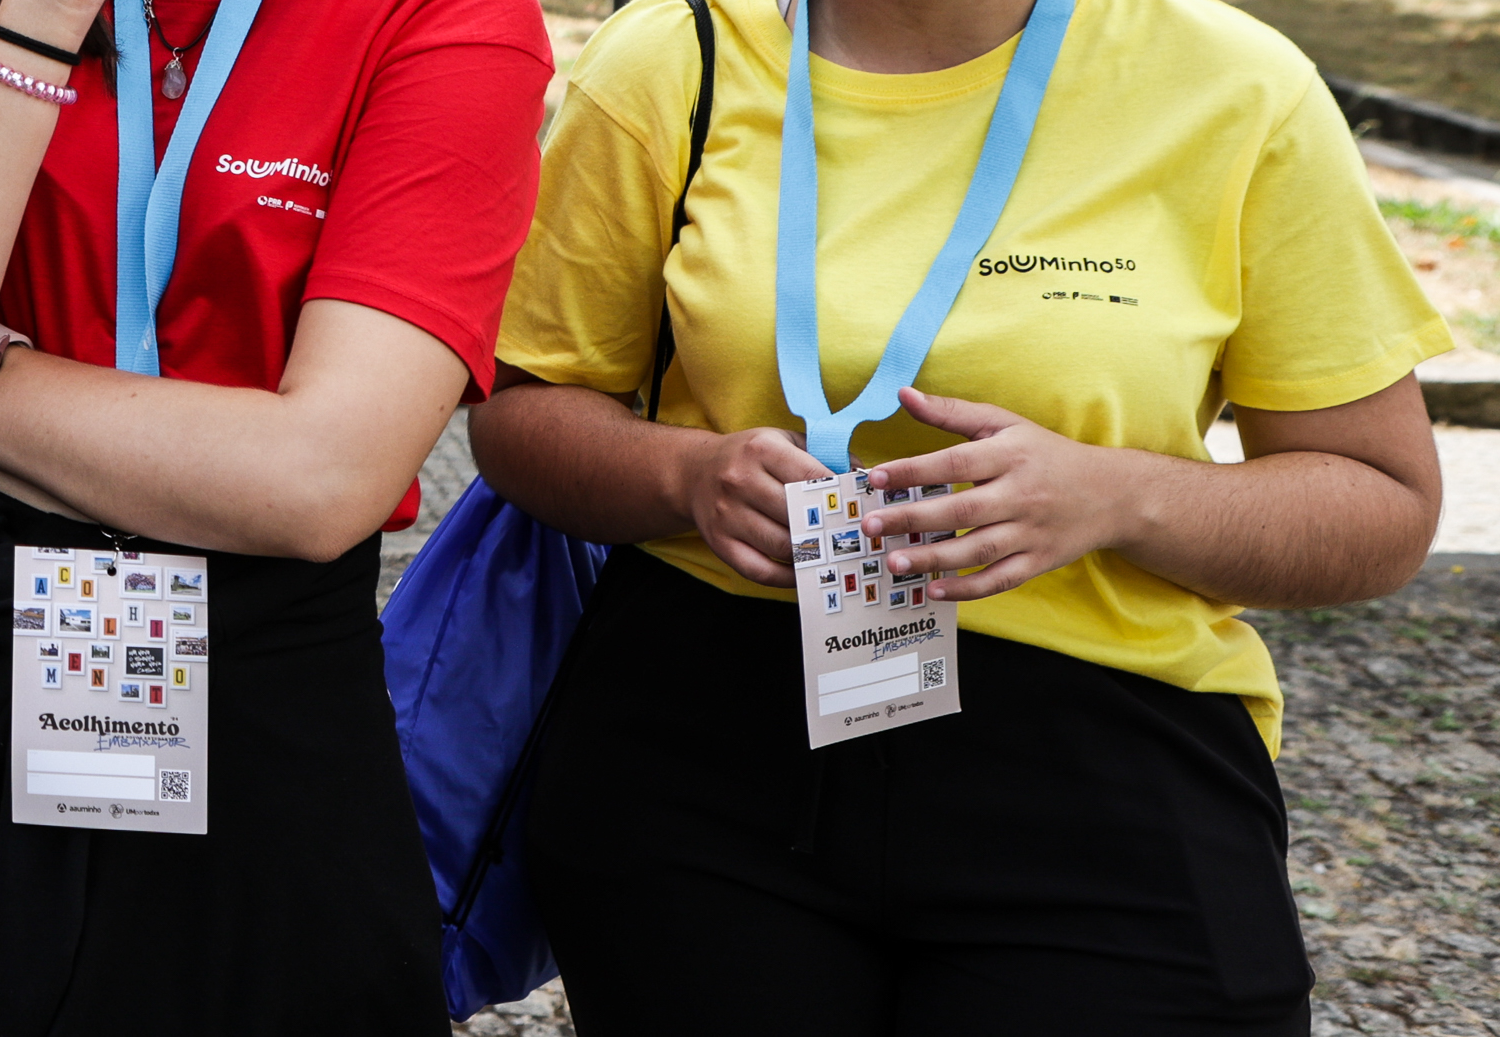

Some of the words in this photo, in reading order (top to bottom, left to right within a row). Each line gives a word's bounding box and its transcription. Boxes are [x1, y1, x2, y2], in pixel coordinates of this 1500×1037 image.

[828, 494, 836, 508] C
[37, 579, 45, 593] A
[60, 568, 68, 582] C
[83, 582, 91, 596] O
[107, 620, 114, 634] L
[129, 606, 138, 621] H
[825, 617, 936, 653] Acolhimento
[47, 668, 57, 683] M
[93, 671, 102, 685] N
[176, 670, 183, 684] O
[39, 713, 179, 736] Acolhimento
[70, 805, 101, 814] aauminho
